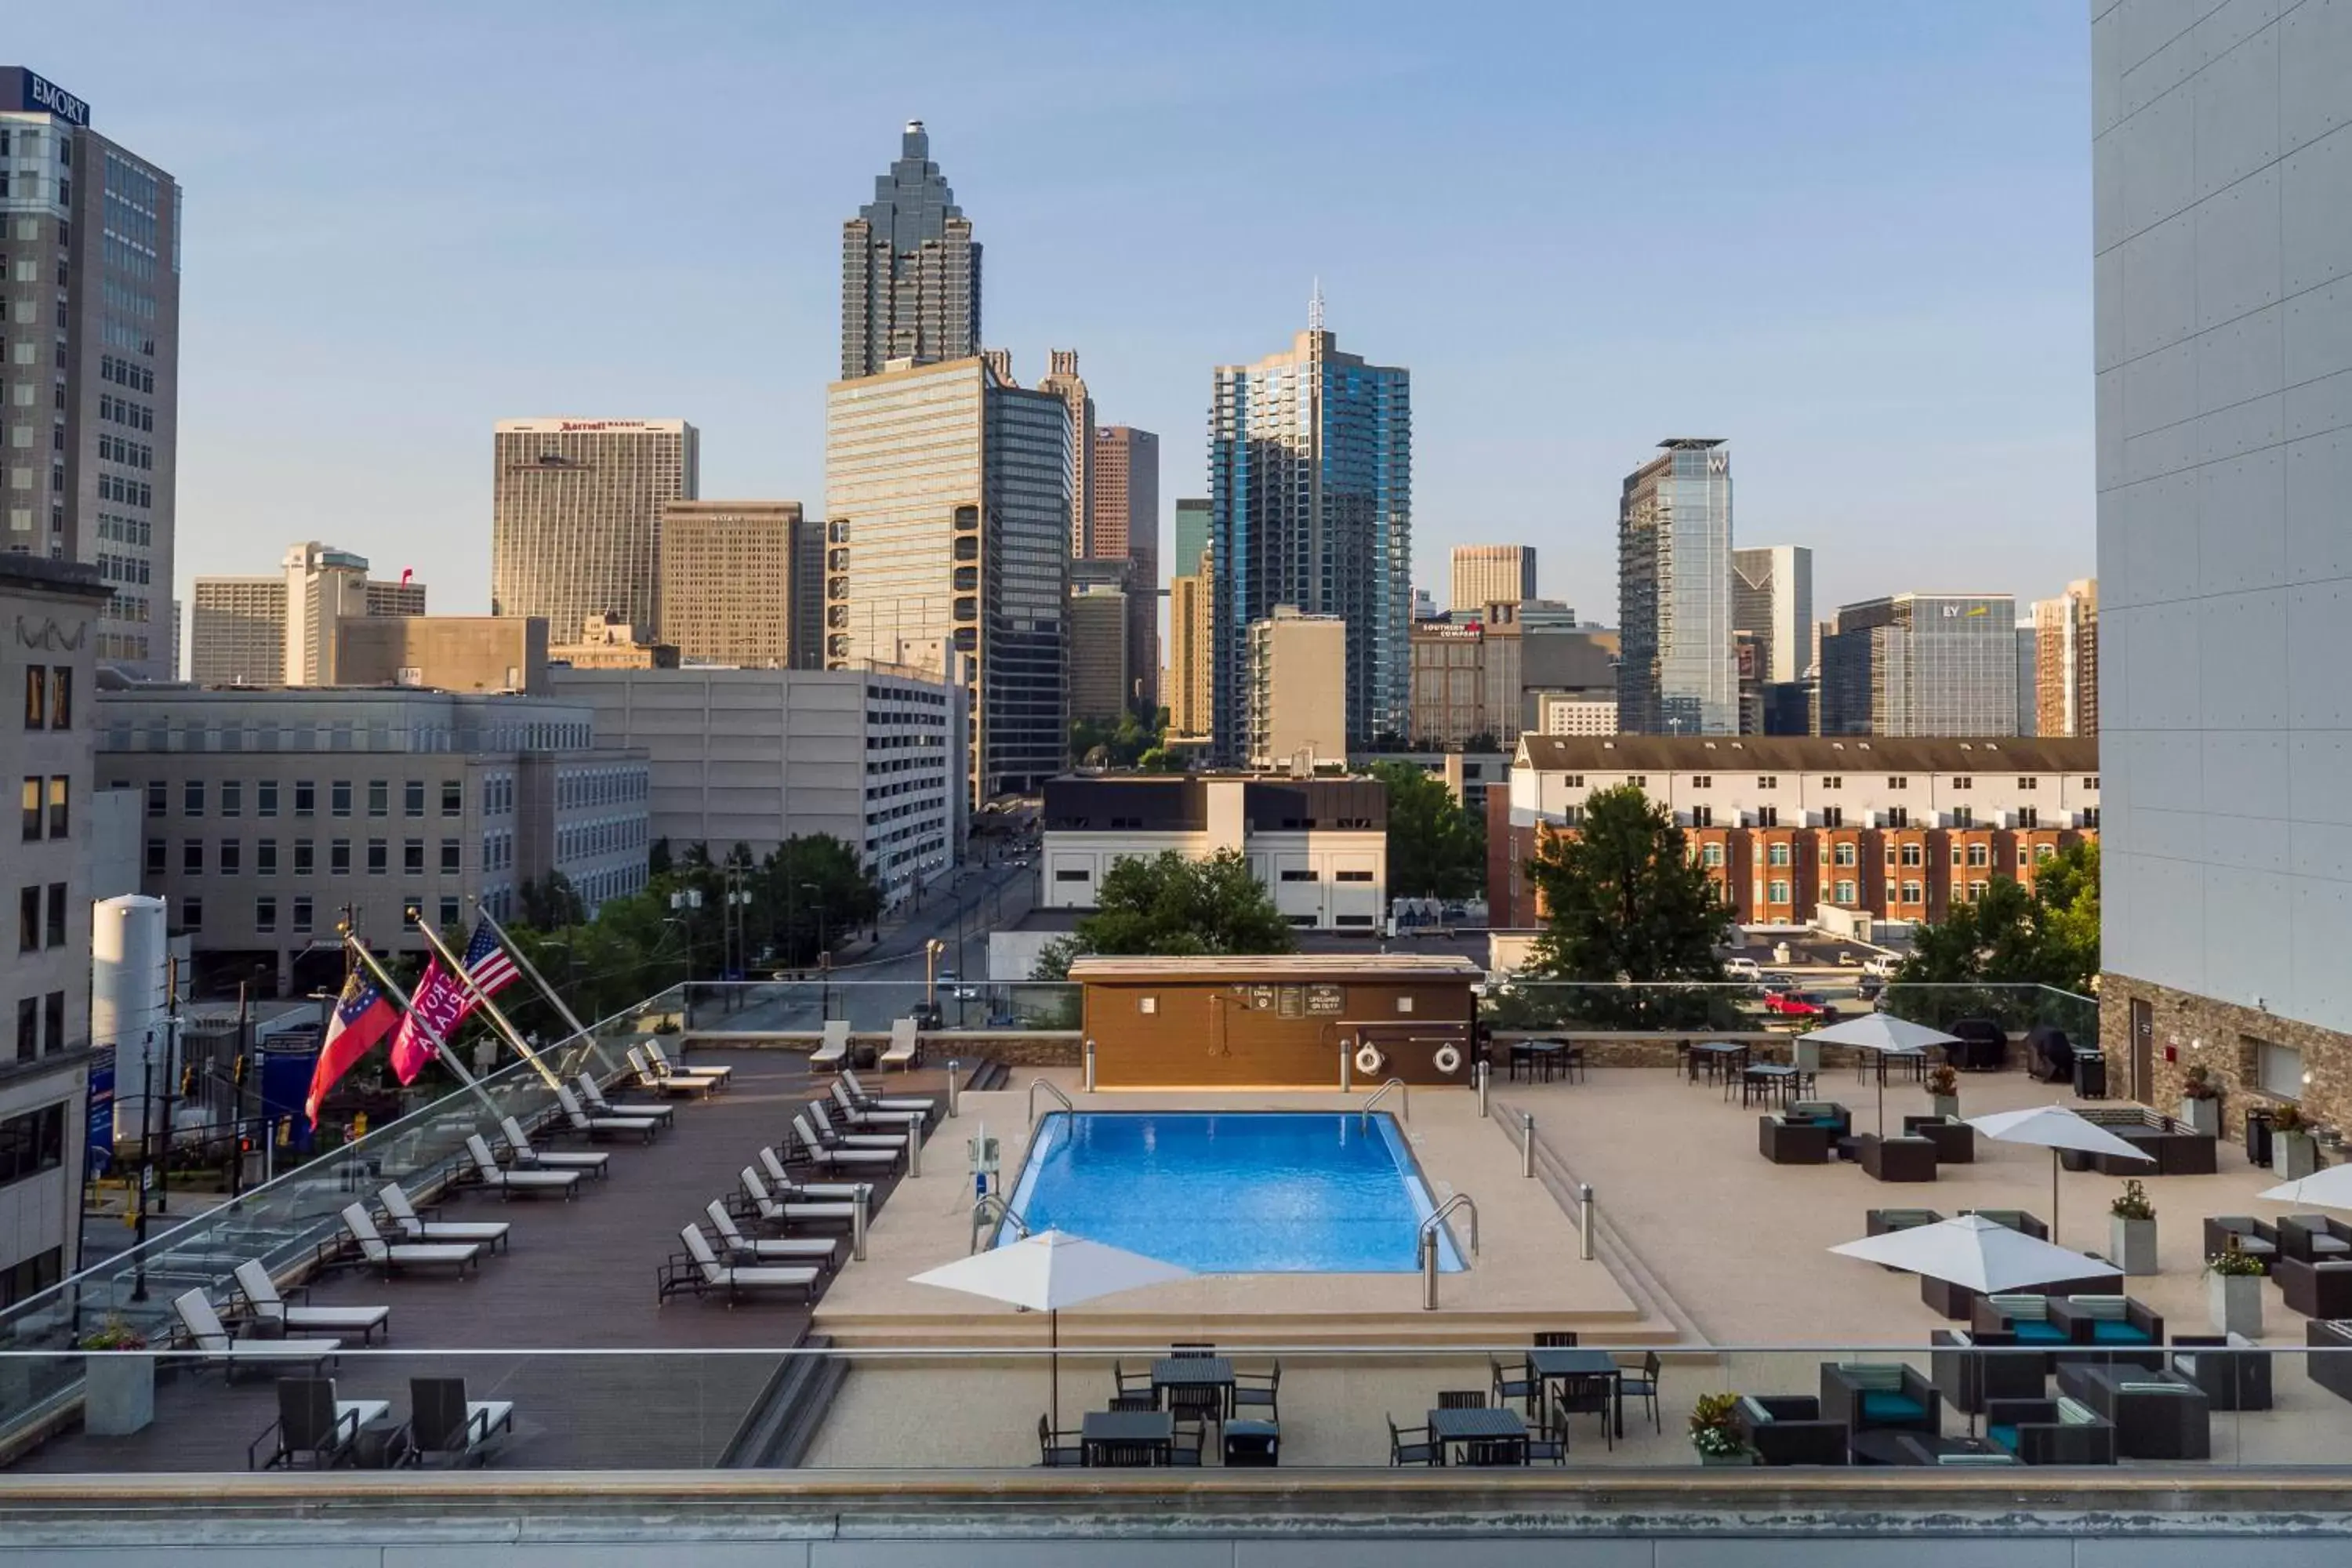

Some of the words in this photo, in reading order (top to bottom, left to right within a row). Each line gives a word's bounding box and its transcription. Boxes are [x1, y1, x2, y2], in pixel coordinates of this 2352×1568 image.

[32, 75, 85, 125] EMORY
[560, 422, 606, 431] Marriott
[1708, 458, 1727, 474] W
[1943, 605, 1959, 617] EY
